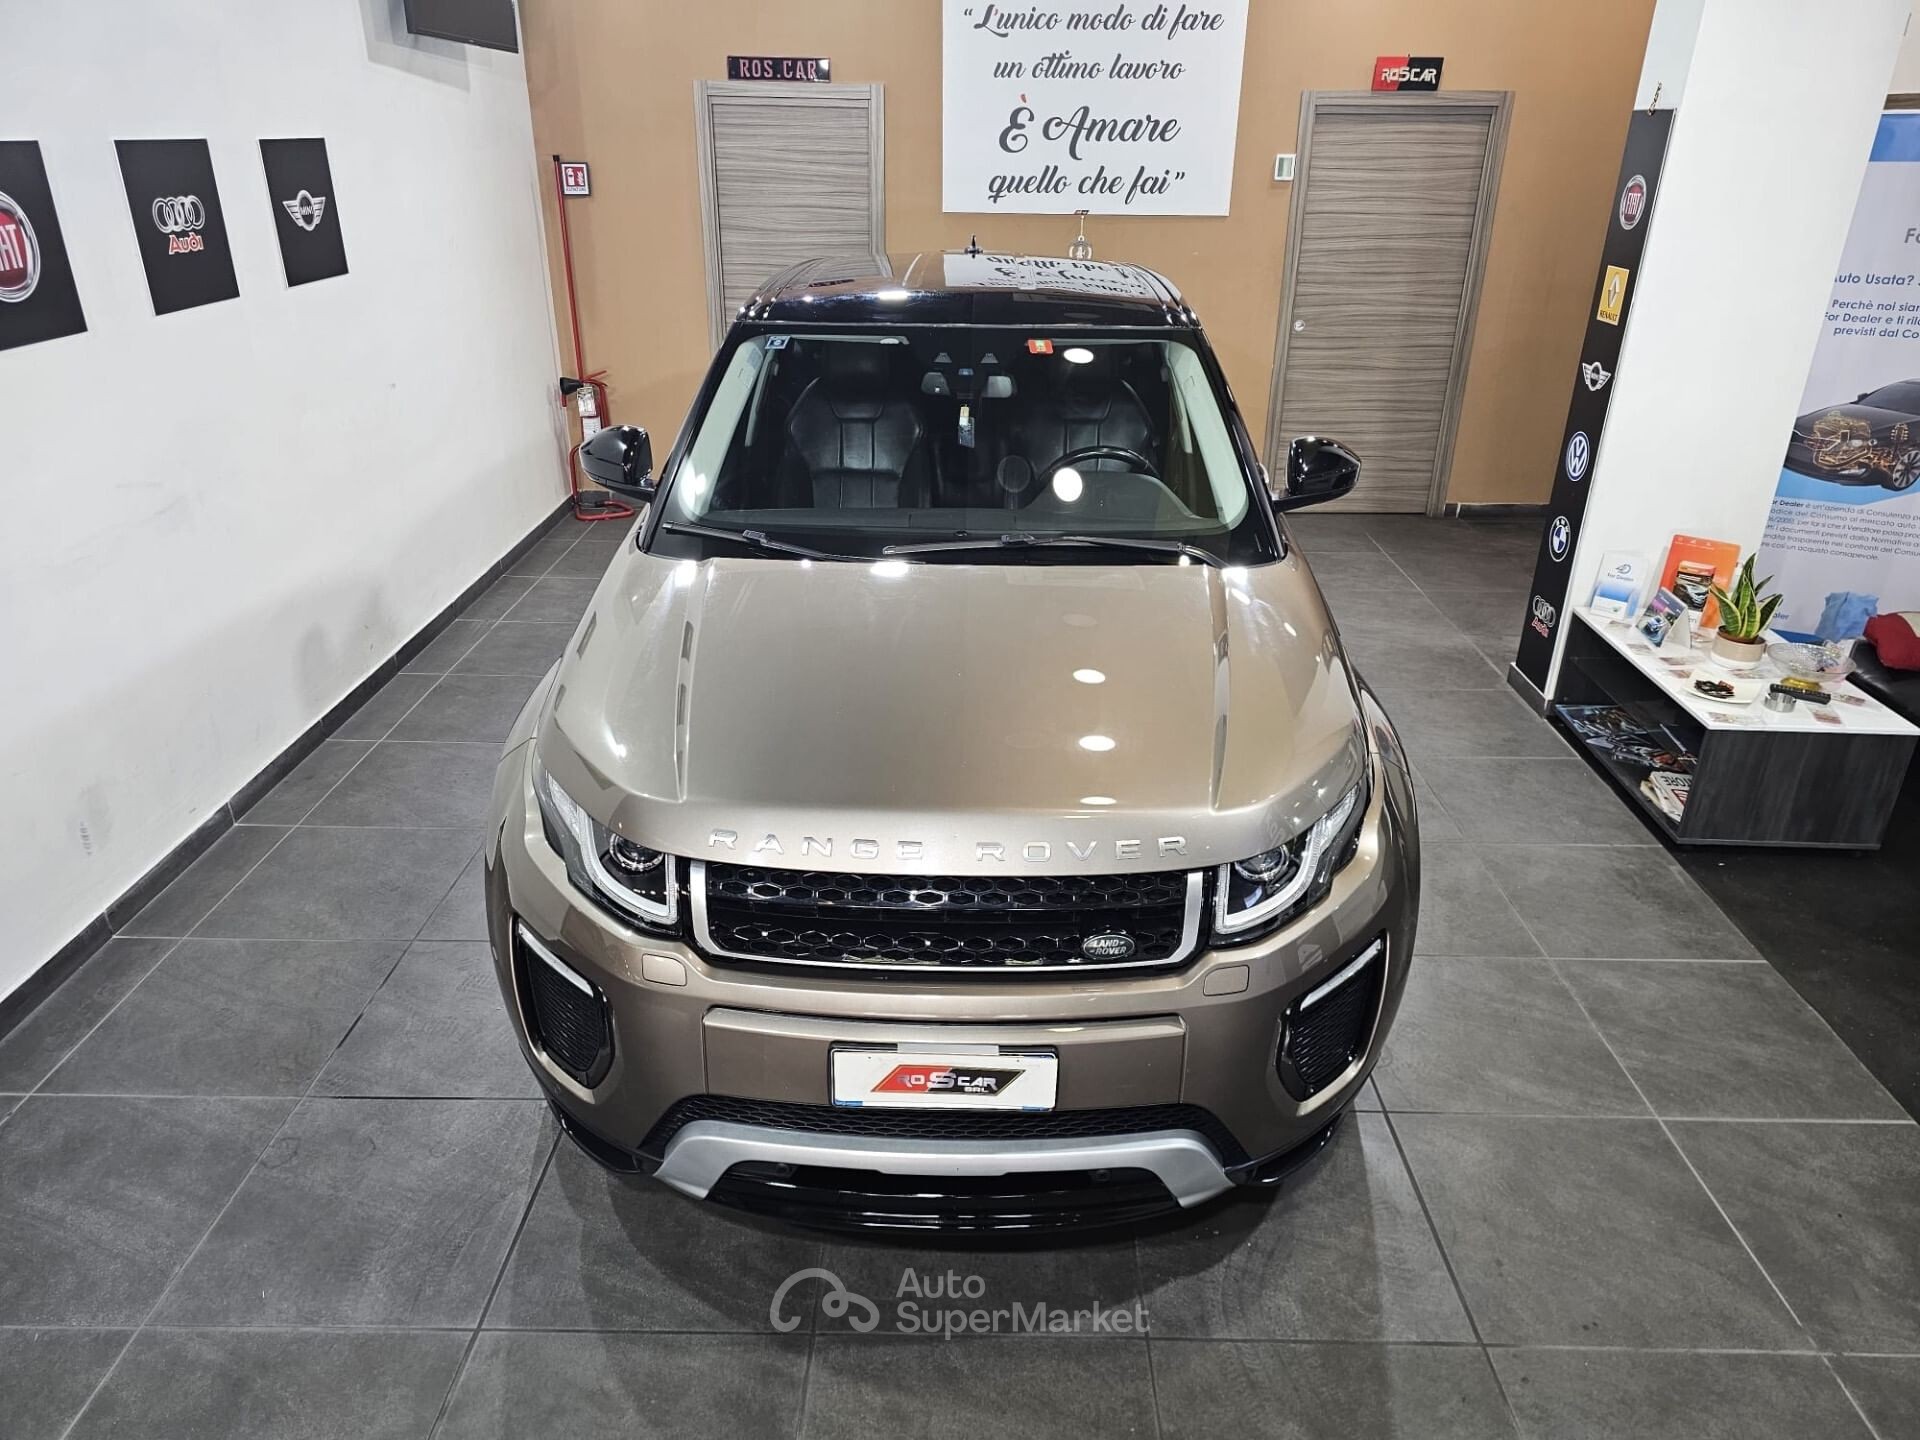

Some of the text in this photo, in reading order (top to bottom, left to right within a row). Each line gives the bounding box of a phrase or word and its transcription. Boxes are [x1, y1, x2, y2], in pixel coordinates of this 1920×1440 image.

[1066, 4, 1136, 31] modo
[1141, 4, 1168, 31] di
[1167, 4, 1225, 41] fare
[993, 50, 1187, 80] un ottimo lavoro
[1381, 66, 1437, 85] ROSCAR
[999, 93, 1182, 161] È Amare
[988, 165, 1072, 204] quello
[1077, 165, 1125, 195] che
[1625, 192, 1642, 215] FIAT
[168, 233, 204, 255] Audi
[1834, 273, 1915, 286] uto Usata?
[1599, 310, 1619, 322] RENAULT
[1842, 313, 1882, 324] Dealer
[1885, 316, 1893, 325] e
[1833, 327, 1877, 337] previsti
[1879, 328, 1899, 338] dal
[707, 827, 1189, 863] RANGE ROVER
